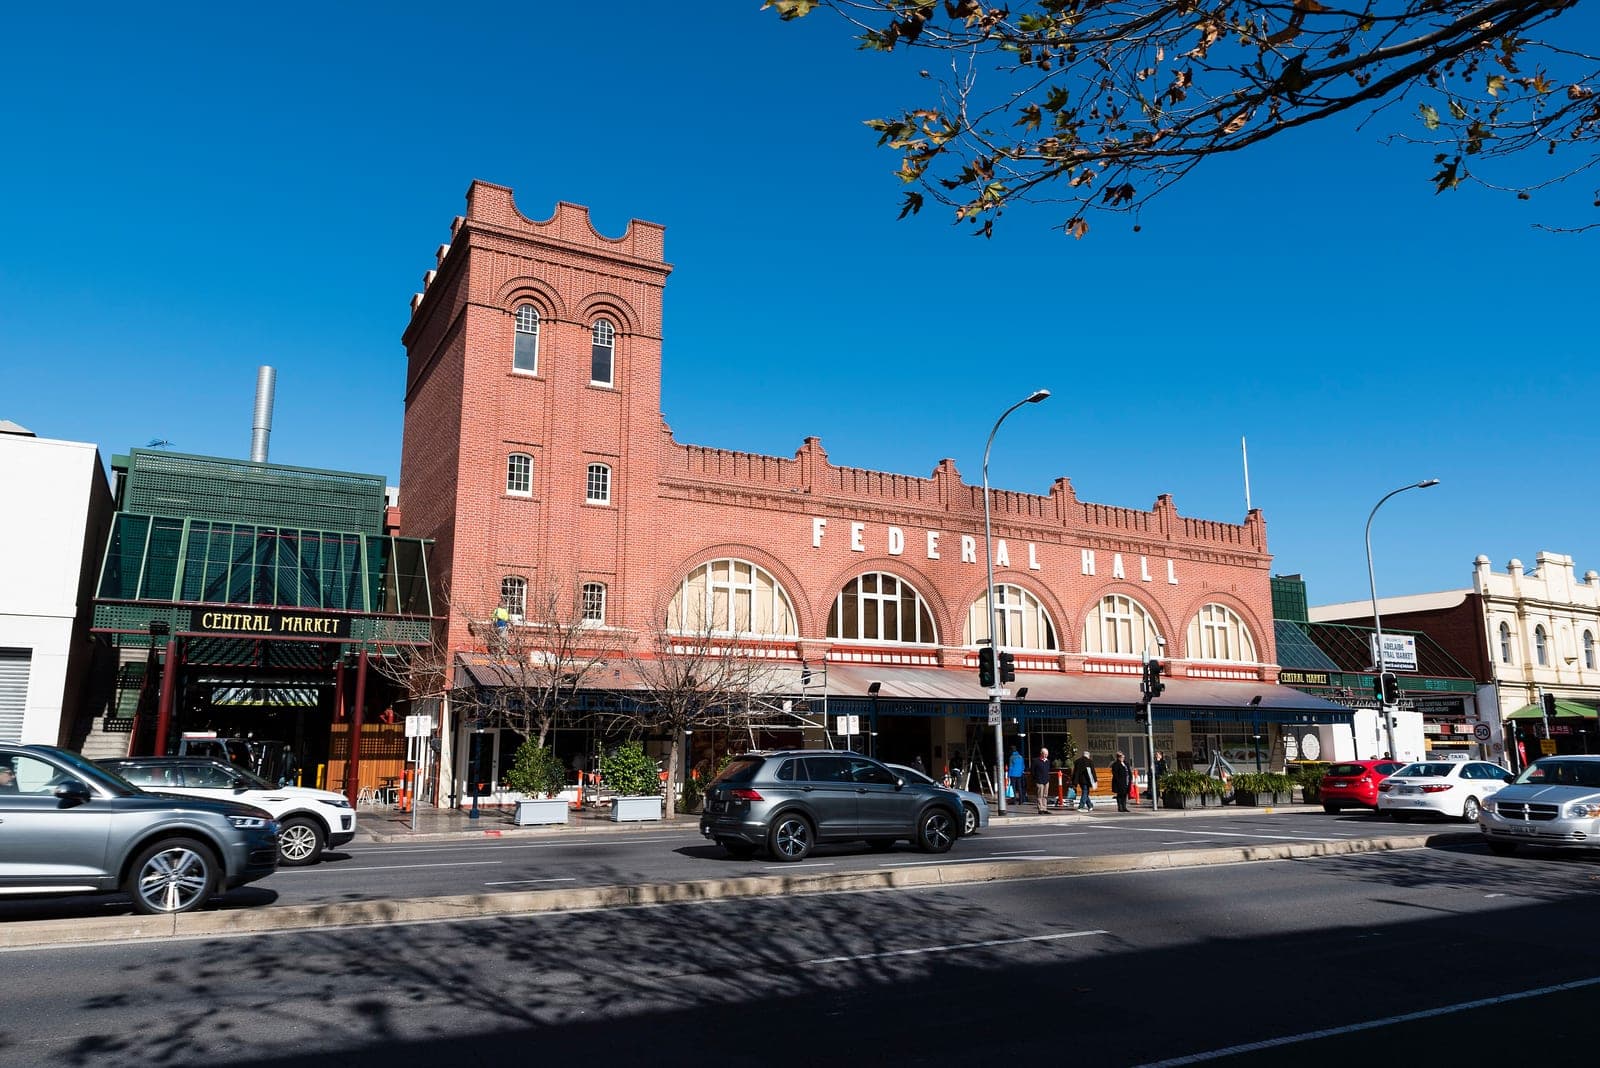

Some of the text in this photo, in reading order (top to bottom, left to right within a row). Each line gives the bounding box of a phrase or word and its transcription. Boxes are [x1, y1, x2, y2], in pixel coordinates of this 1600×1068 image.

[812, 518, 1179, 585] FEDERAL HALL
[202, 612, 341, 634] CENTRAL MARKET
[1395, 652, 1413, 660] MARKET
[1281, 672, 1327, 684] CENTRAL MARKET
[1476, 728, 1488, 737] 50
[1088, 739, 1115, 750] MARKET
